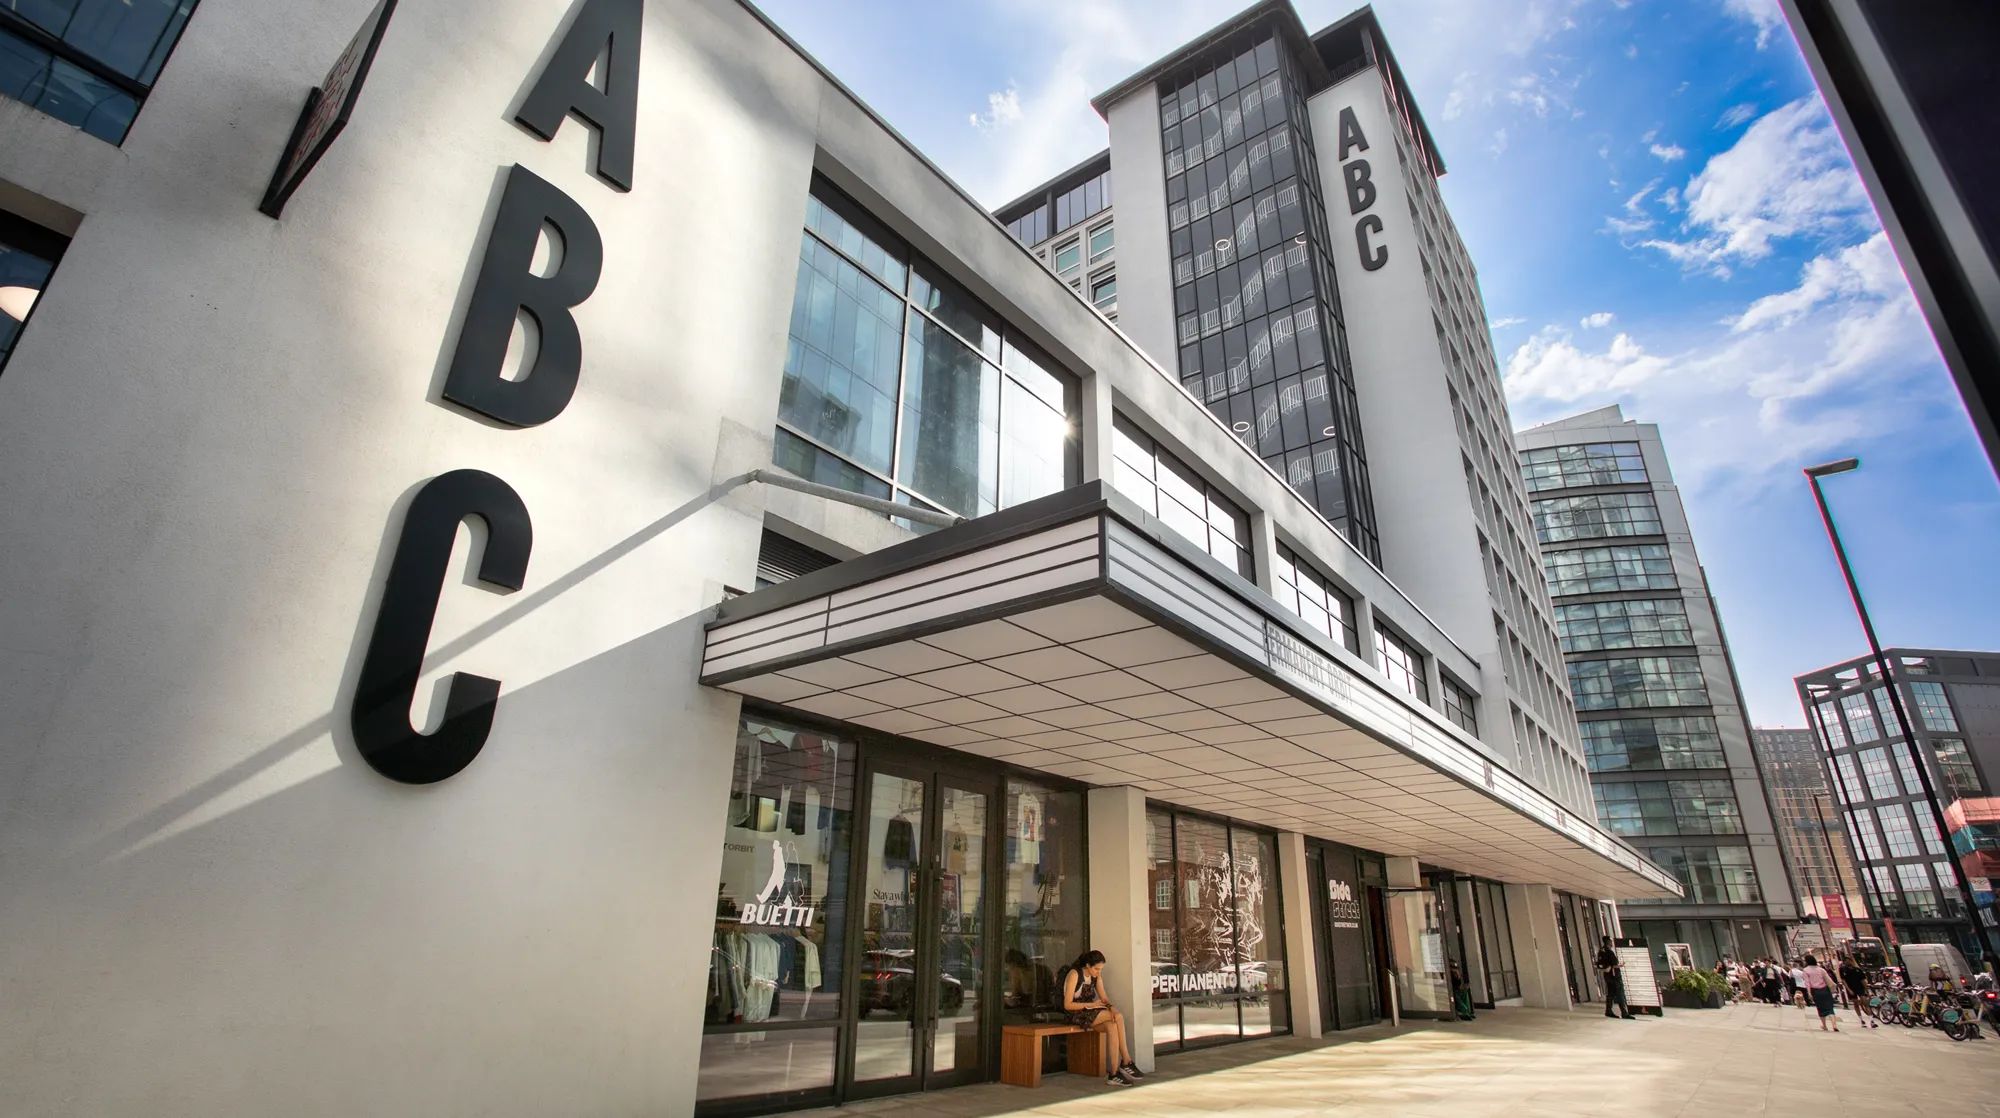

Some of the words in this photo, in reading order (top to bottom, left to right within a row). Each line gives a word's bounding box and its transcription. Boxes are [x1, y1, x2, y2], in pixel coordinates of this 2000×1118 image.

[1338, 105, 1389, 272] ABC
[352, 0, 644, 785] ABC
[740, 903, 814, 927] BUETTI
[1151, 972, 1228, 993] PERMANENT
